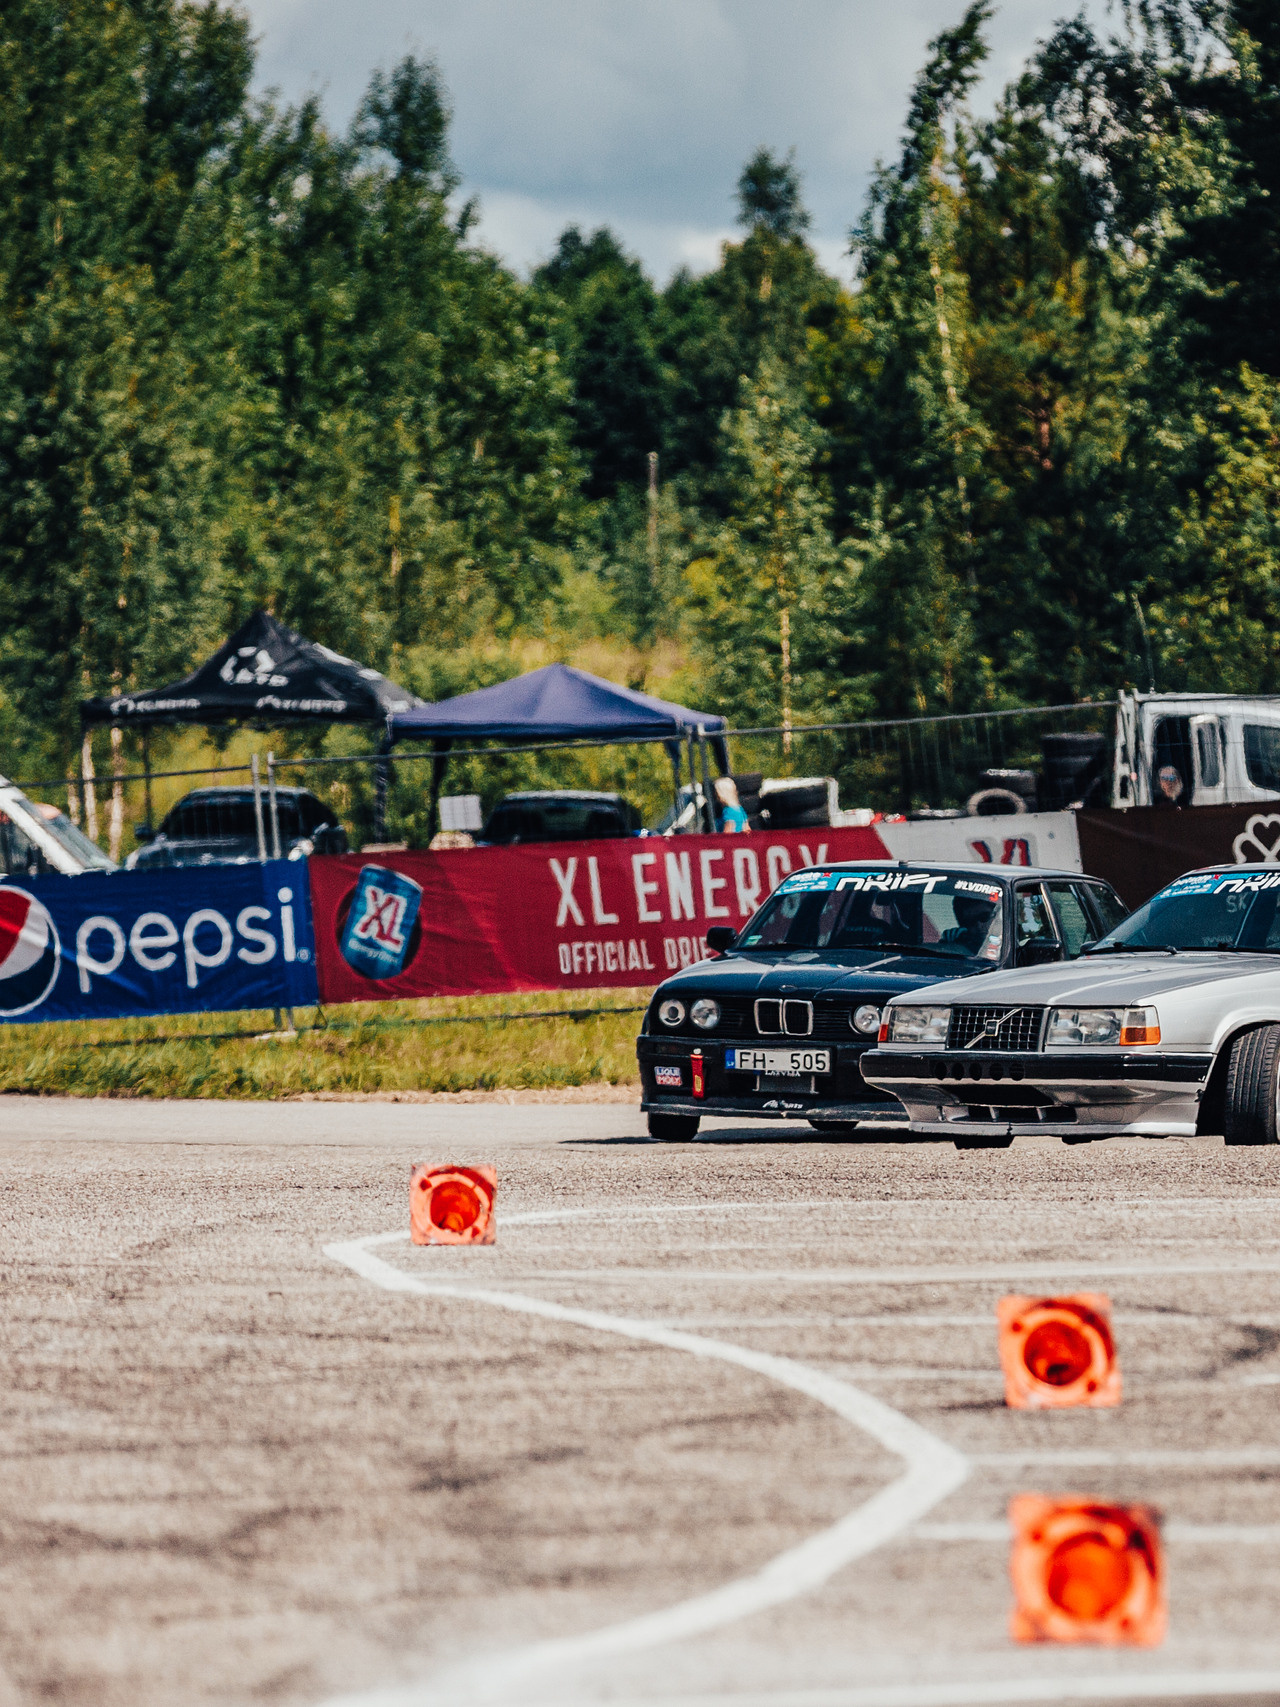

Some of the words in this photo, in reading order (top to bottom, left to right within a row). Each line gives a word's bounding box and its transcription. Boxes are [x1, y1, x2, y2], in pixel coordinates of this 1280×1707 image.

[550, 855, 619, 927] XL
[76, 886, 298, 994] pepsi
[558, 938, 655, 974] OFFICIAL
[664, 935, 712, 970] DRIF
[790, 1053, 827, 1071] 505
